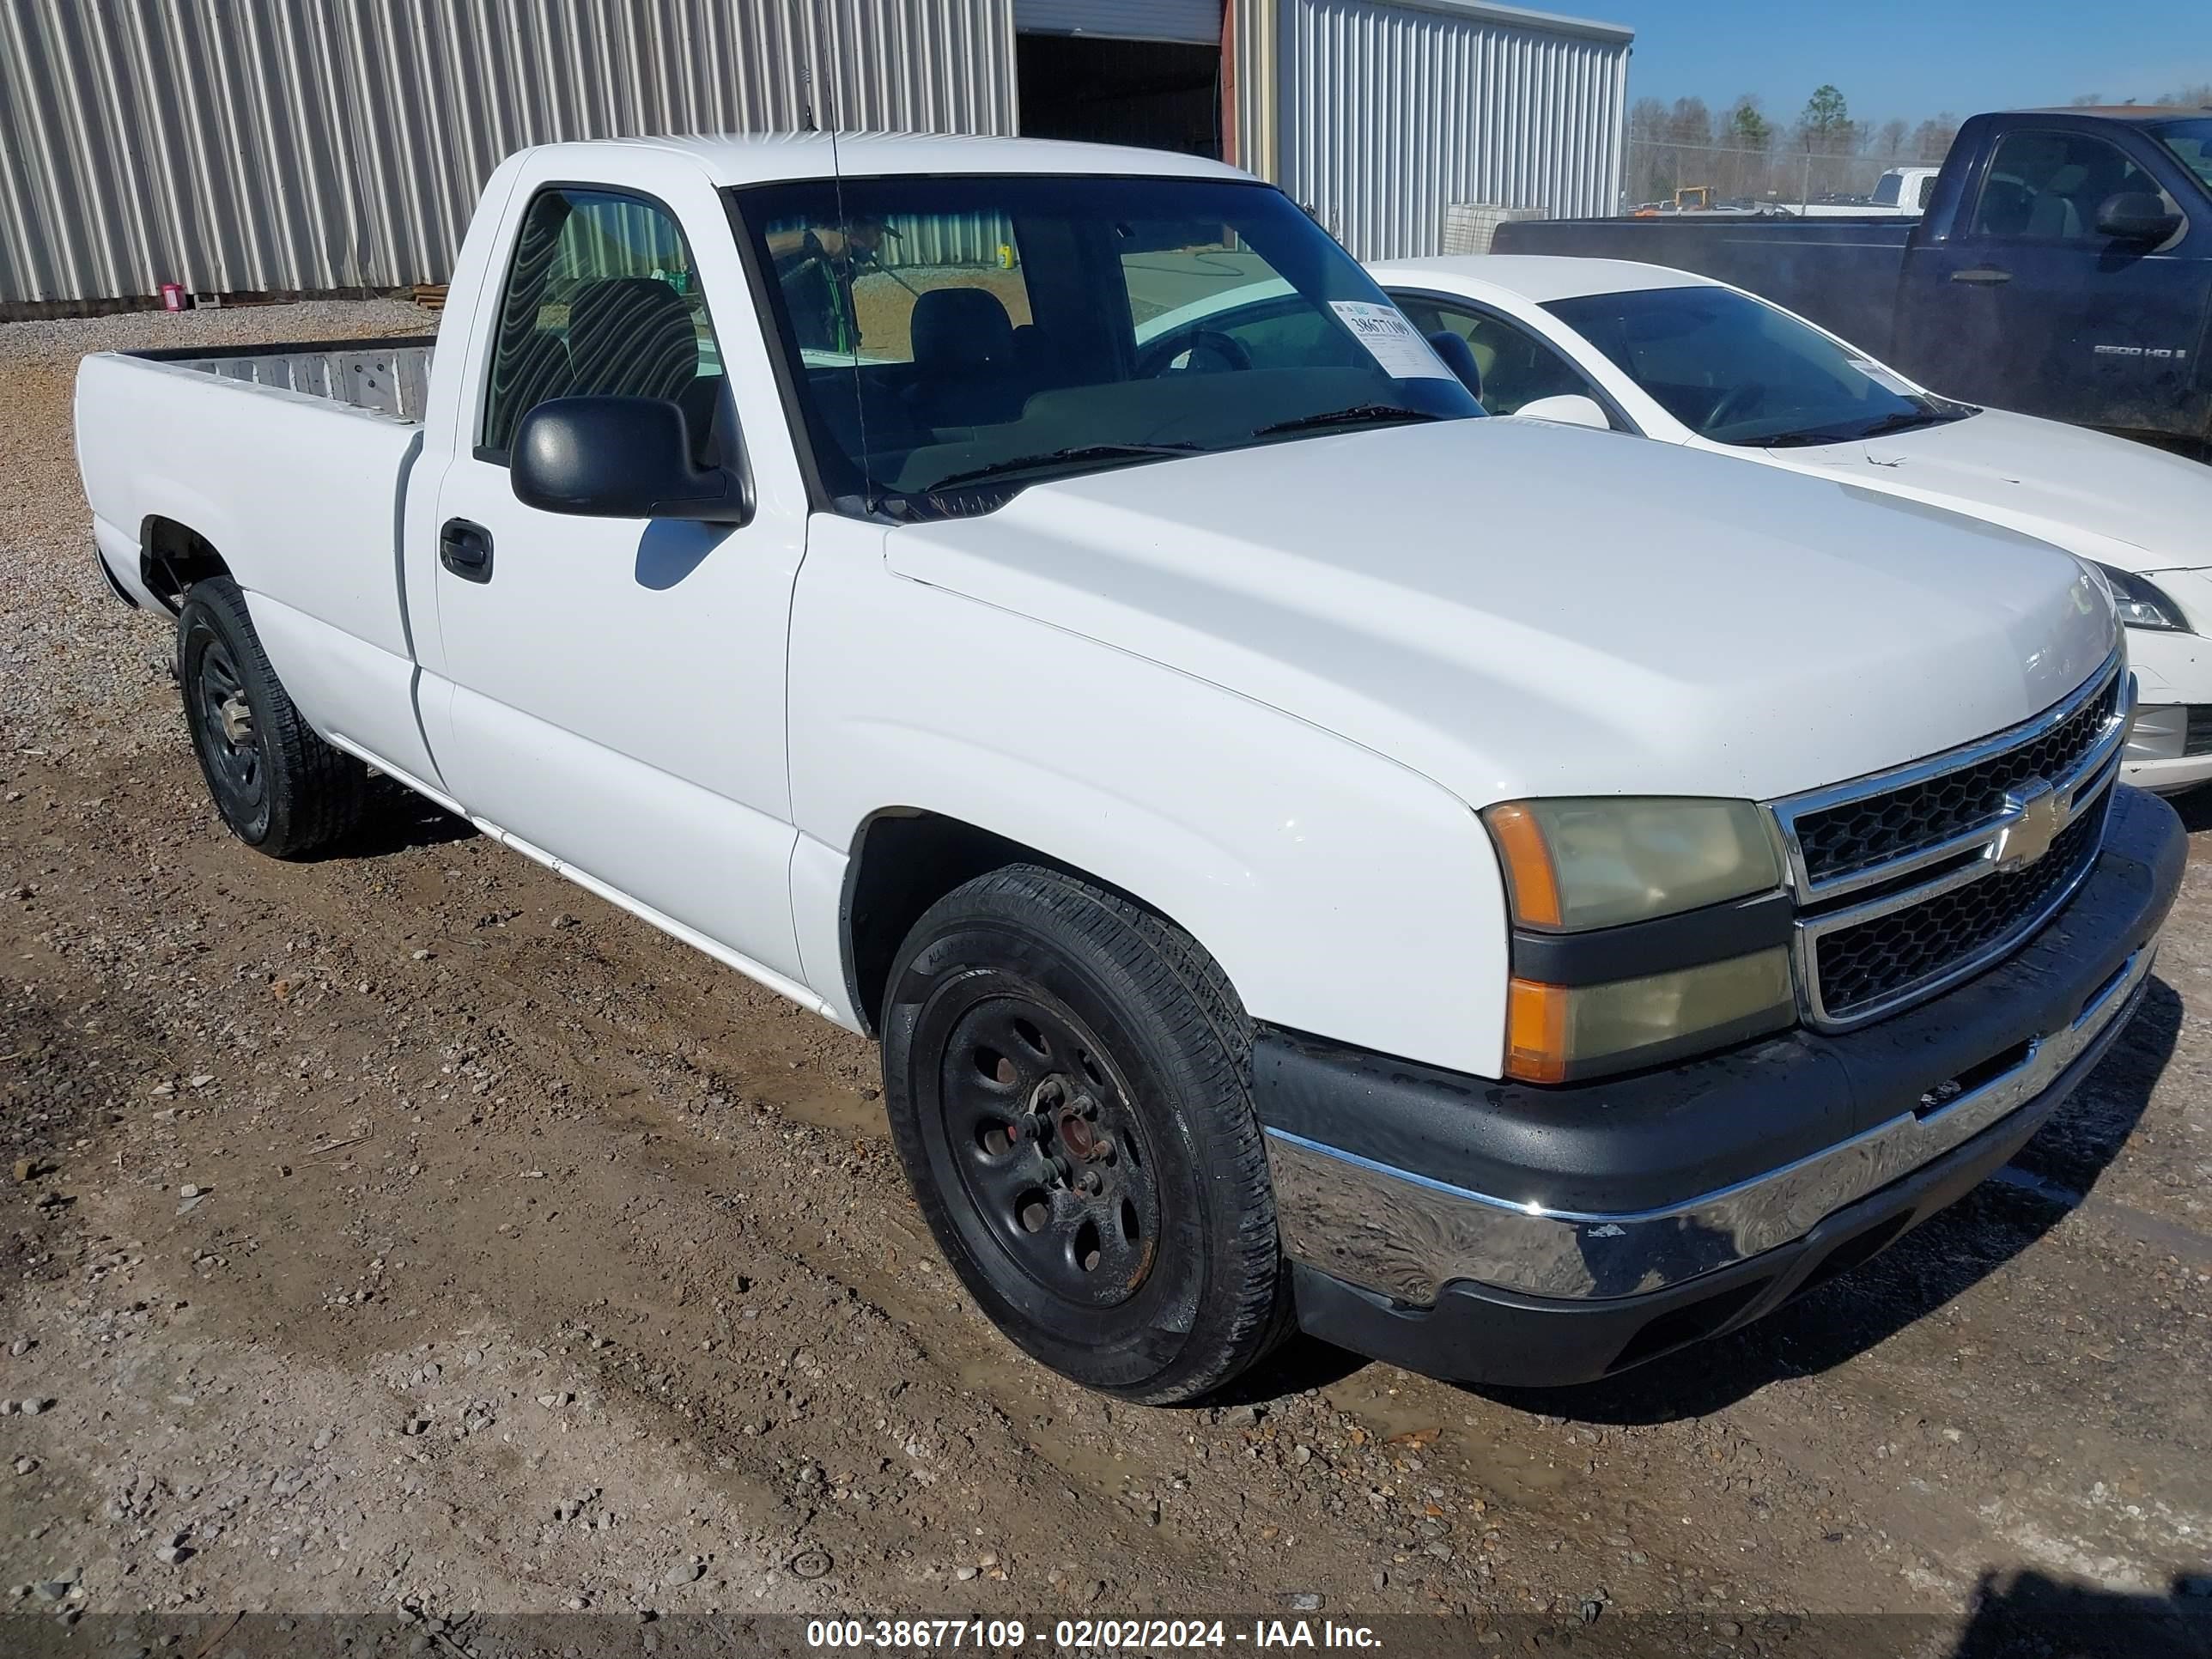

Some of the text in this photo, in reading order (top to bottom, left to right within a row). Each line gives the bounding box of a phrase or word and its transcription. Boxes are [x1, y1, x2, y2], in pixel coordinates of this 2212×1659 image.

[1352, 318, 1410, 335] 38677109
[2094, 345, 2172, 357] 2500 HD
